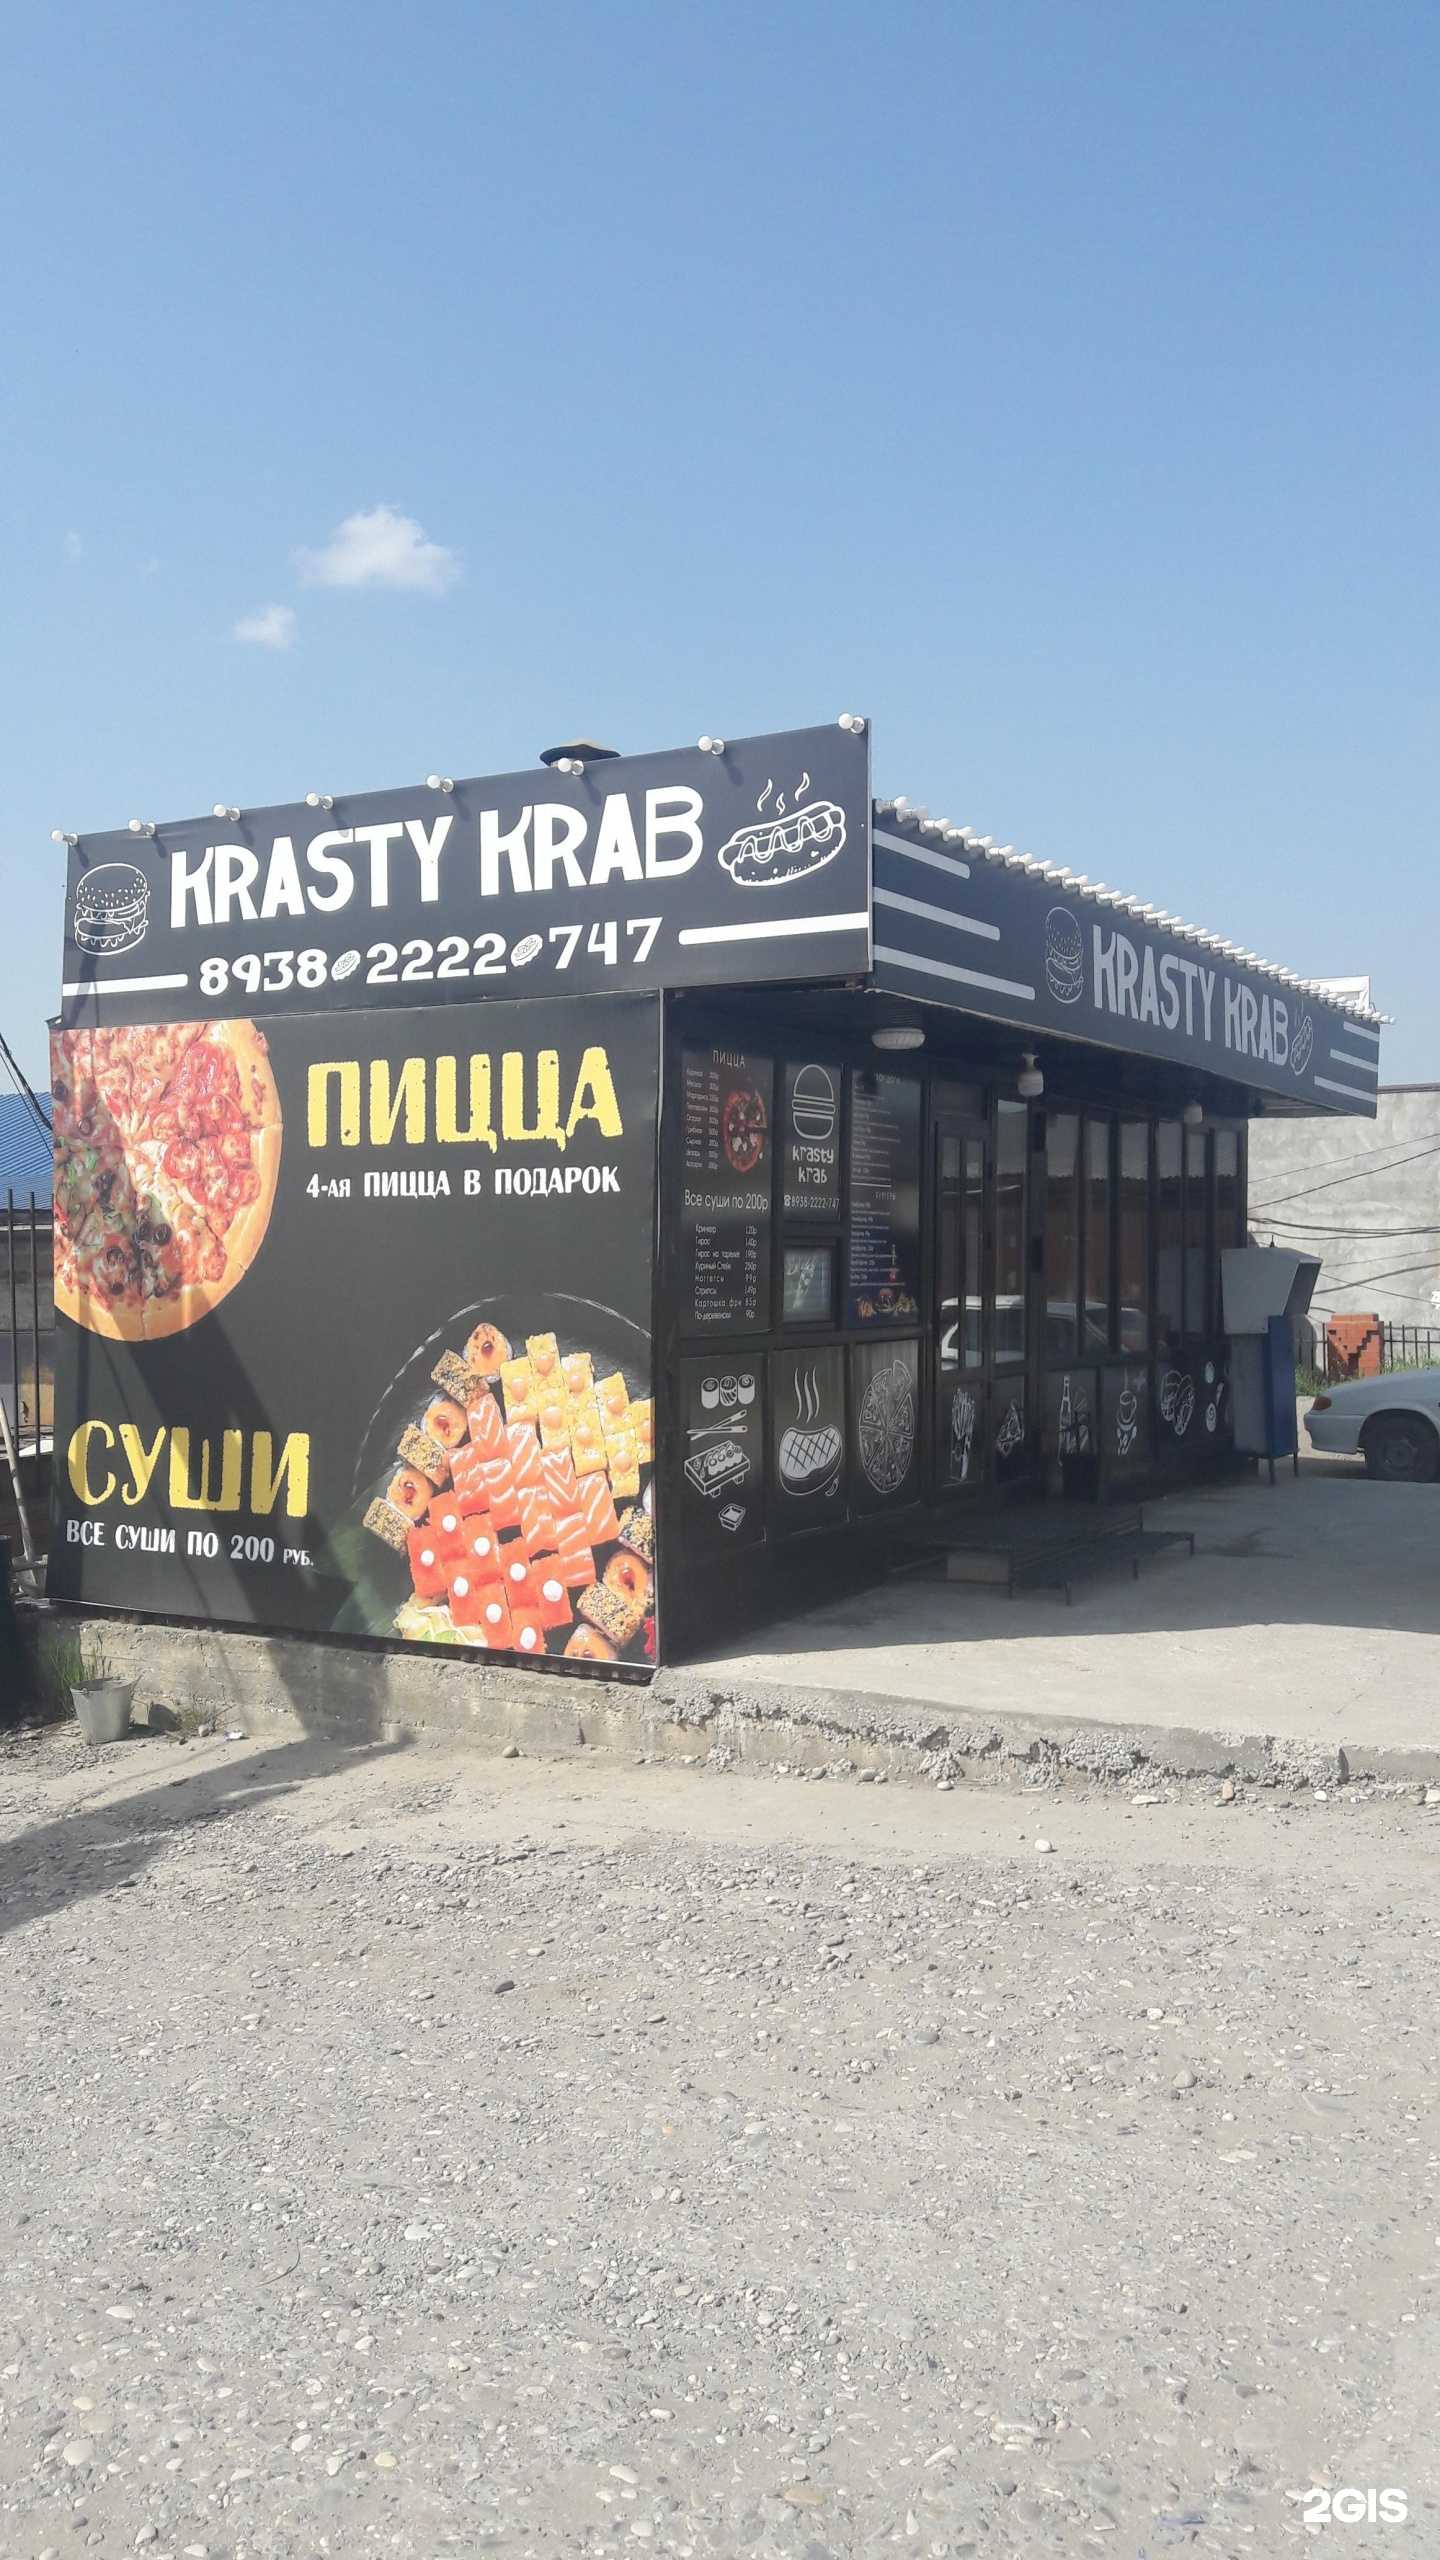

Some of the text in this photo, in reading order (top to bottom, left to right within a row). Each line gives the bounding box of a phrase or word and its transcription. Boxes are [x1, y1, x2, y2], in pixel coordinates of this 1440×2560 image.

[170, 785, 703, 929] KRASTY KRAB
[200, 916, 662, 996] 8938 2222 747
[1093, 924, 1289, 1065] KRASTY KRAB
[712, 1049, 746, 1069] ПИЦЦА
[308, 1046, 624, 1154] ПИЦЦА
[792, 1145, 834, 1164] krasty
[798, 1166, 828, 1184] krab
[364, 1169, 451, 1200] ПИЦЦА
[464, 1169, 481, 1196] В
[495, 1166, 621, 1198] ПОДАРОК
[685, 1189, 703, 1207] Все
[705, 1194, 730, 1212] суши
[732, 1196, 744, 1208] по
[68, 1420, 310, 1518] СУШИ
[67, 1519, 314, 1567] ВСЕ СУШИ ПО 200 РУБ.
